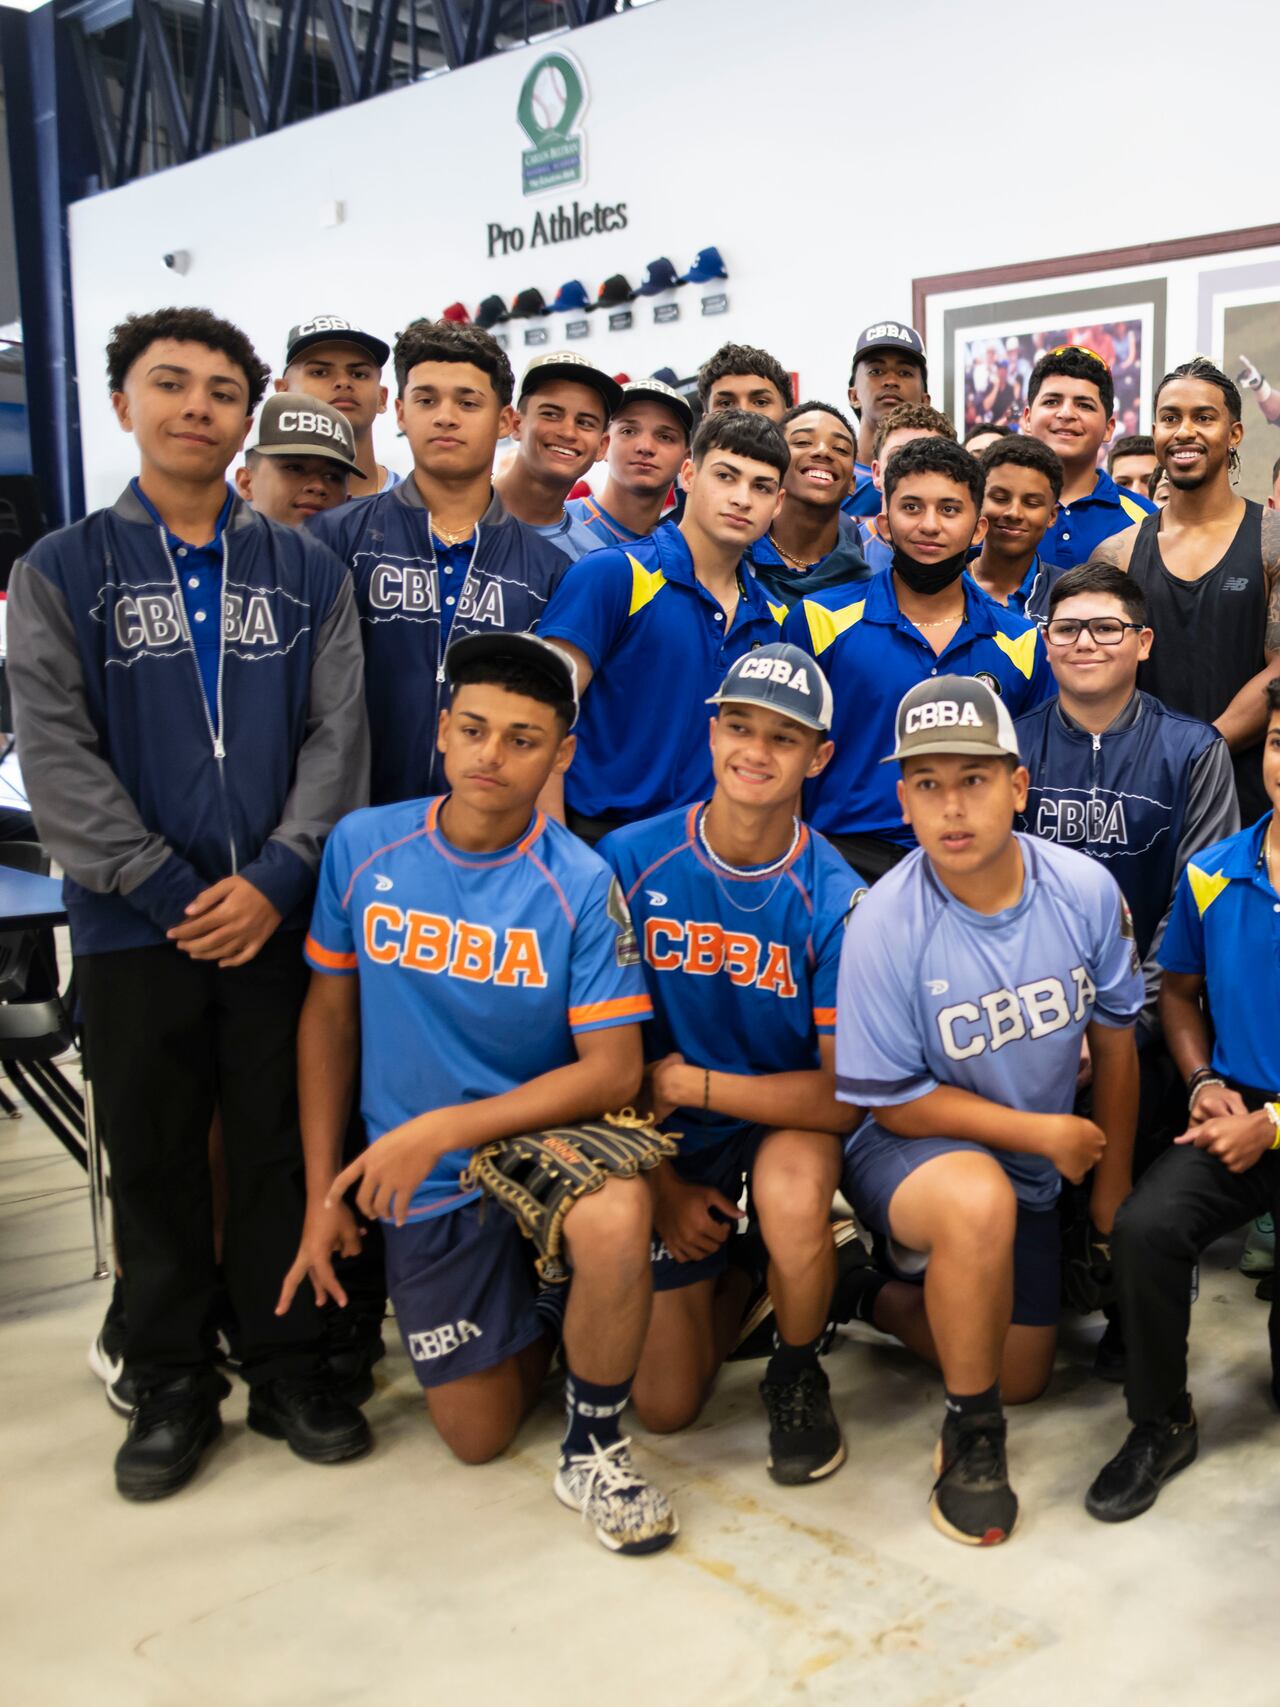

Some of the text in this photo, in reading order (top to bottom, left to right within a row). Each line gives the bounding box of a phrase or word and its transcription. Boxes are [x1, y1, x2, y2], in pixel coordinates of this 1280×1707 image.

[487, 201, 627, 258] Pro Athletes
[865, 324, 913, 343] CBBA
[278, 411, 349, 446] CBBA
[738, 658, 811, 696] CBBA
[904, 700, 984, 735] CBBA
[1037, 798, 1128, 845] CBBA
[364, 902, 548, 988] CBBA
[644, 916, 798, 999] CBBA
[936, 965, 1096, 1061] CBBA
[408, 1319, 483, 1361] CBBA
